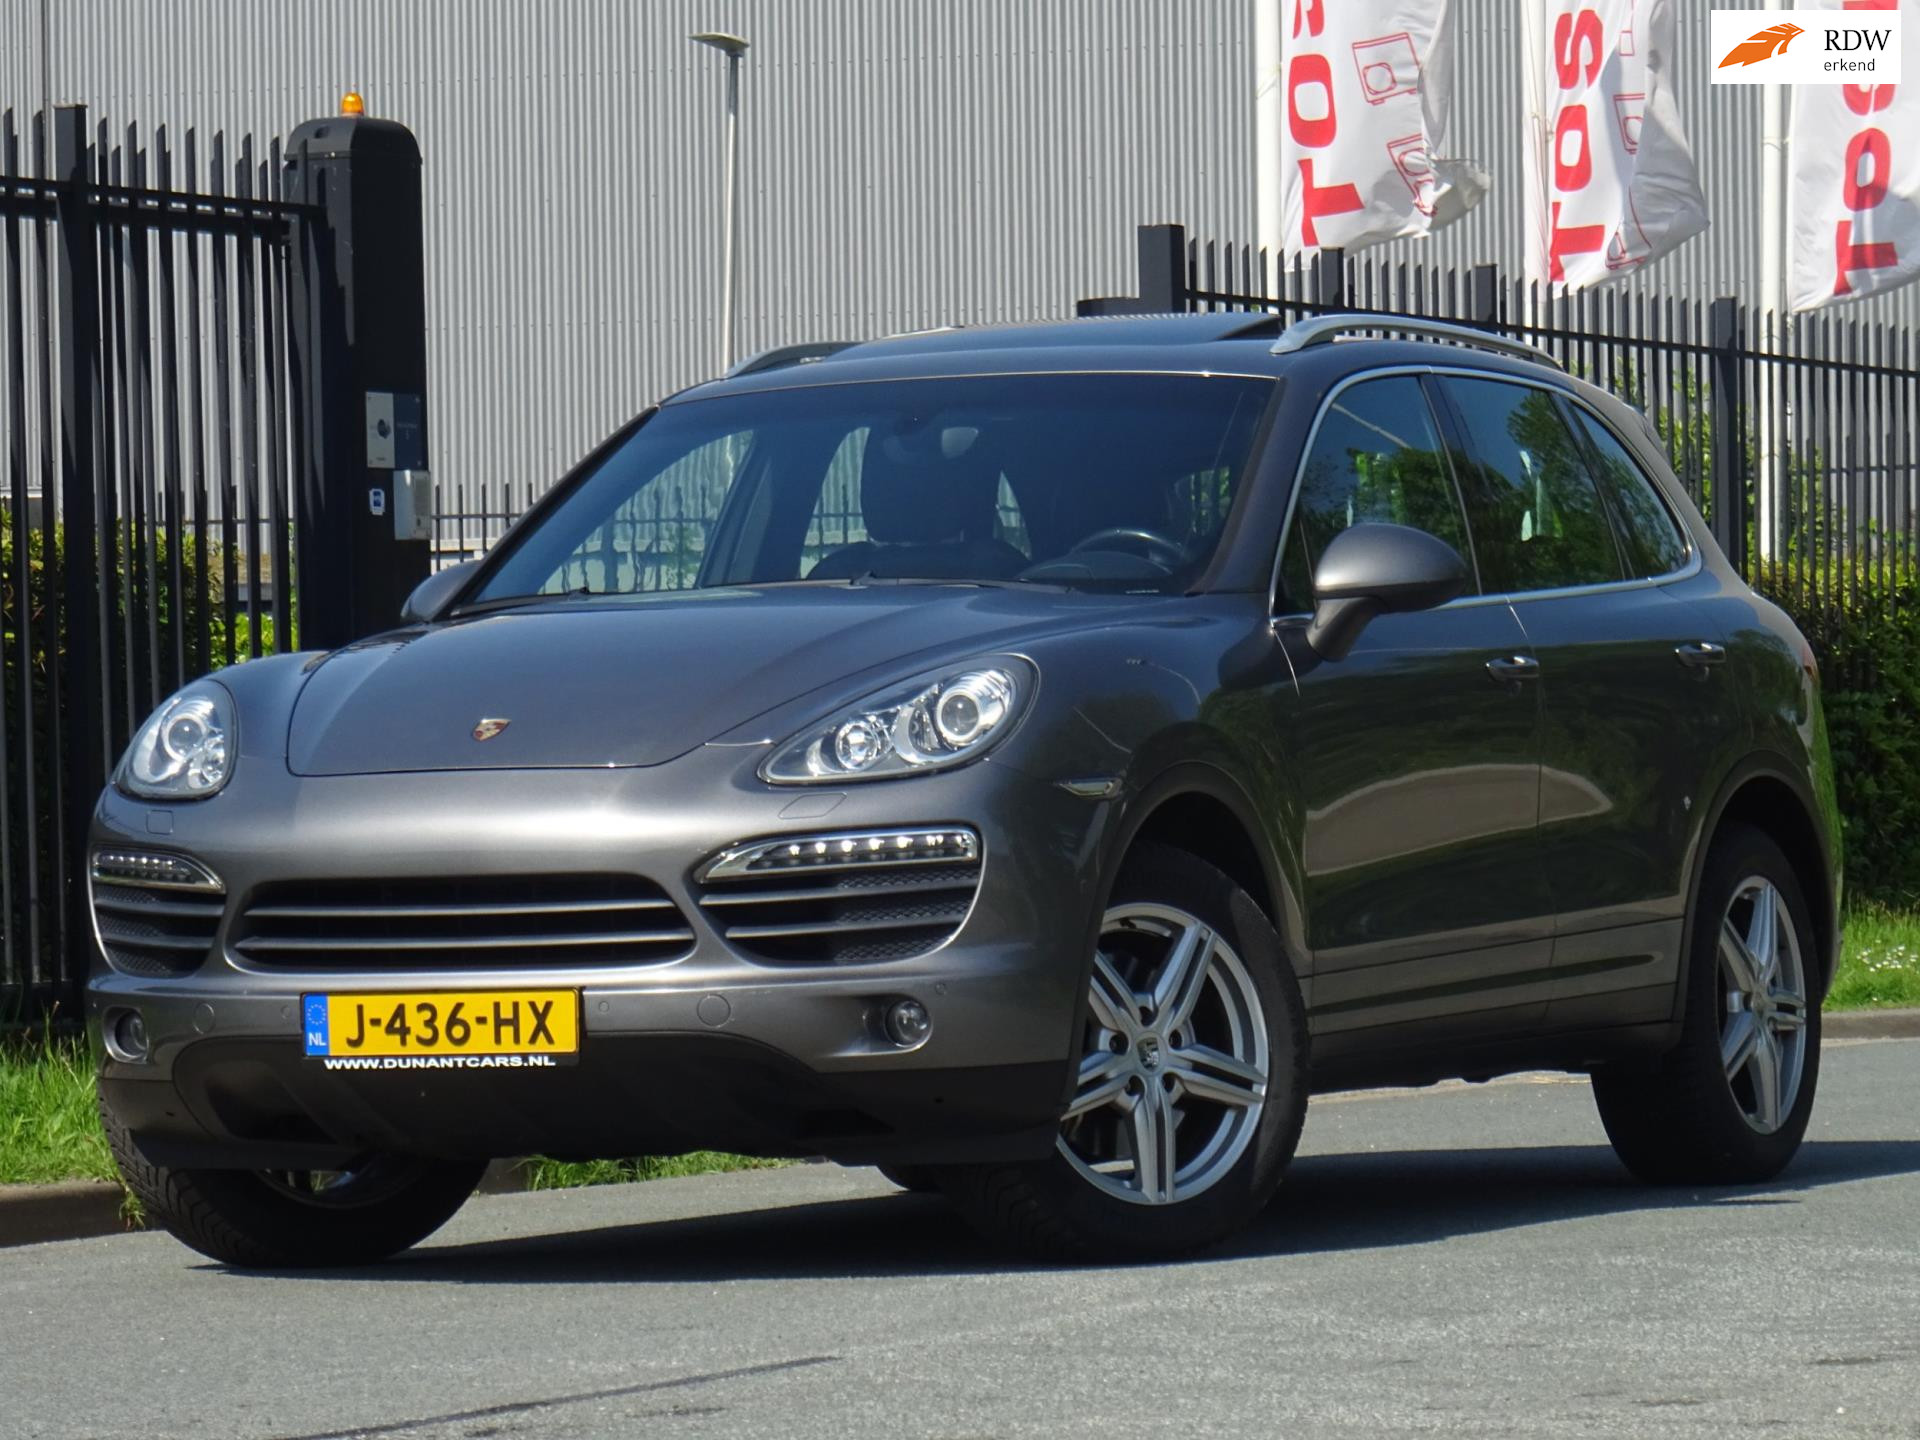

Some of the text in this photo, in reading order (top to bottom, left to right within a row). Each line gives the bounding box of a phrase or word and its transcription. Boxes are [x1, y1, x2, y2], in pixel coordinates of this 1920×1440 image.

[346, 1000, 555, 1048] J-436-HX
[308, 1032, 327, 1047] NL
[324, 1056, 556, 1070] WWW.DUNANTCARS.NL
